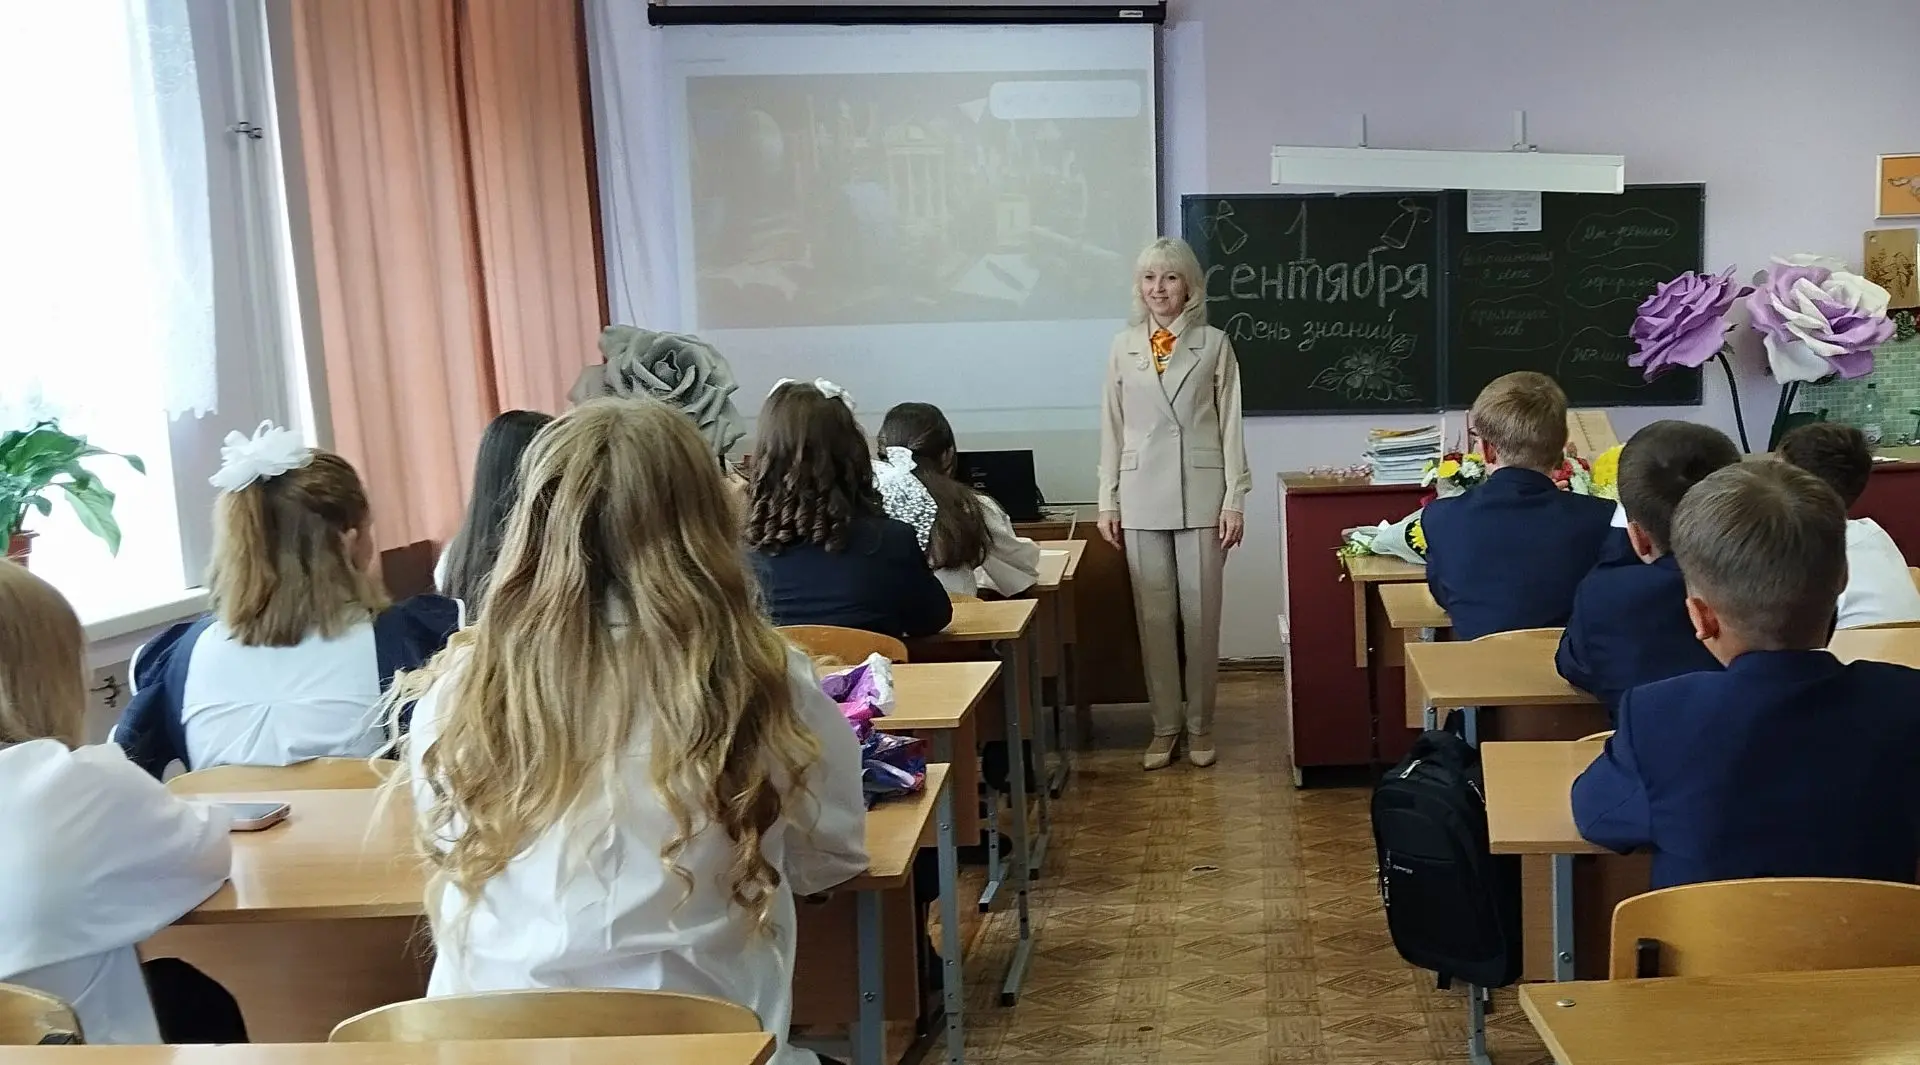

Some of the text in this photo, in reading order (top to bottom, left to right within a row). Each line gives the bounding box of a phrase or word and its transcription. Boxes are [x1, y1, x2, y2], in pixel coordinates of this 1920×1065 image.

[1284, 200, 1307, 259] 1
[1204, 246, 1428, 307] сентября
[1224, 309, 1396, 351] День знаний
